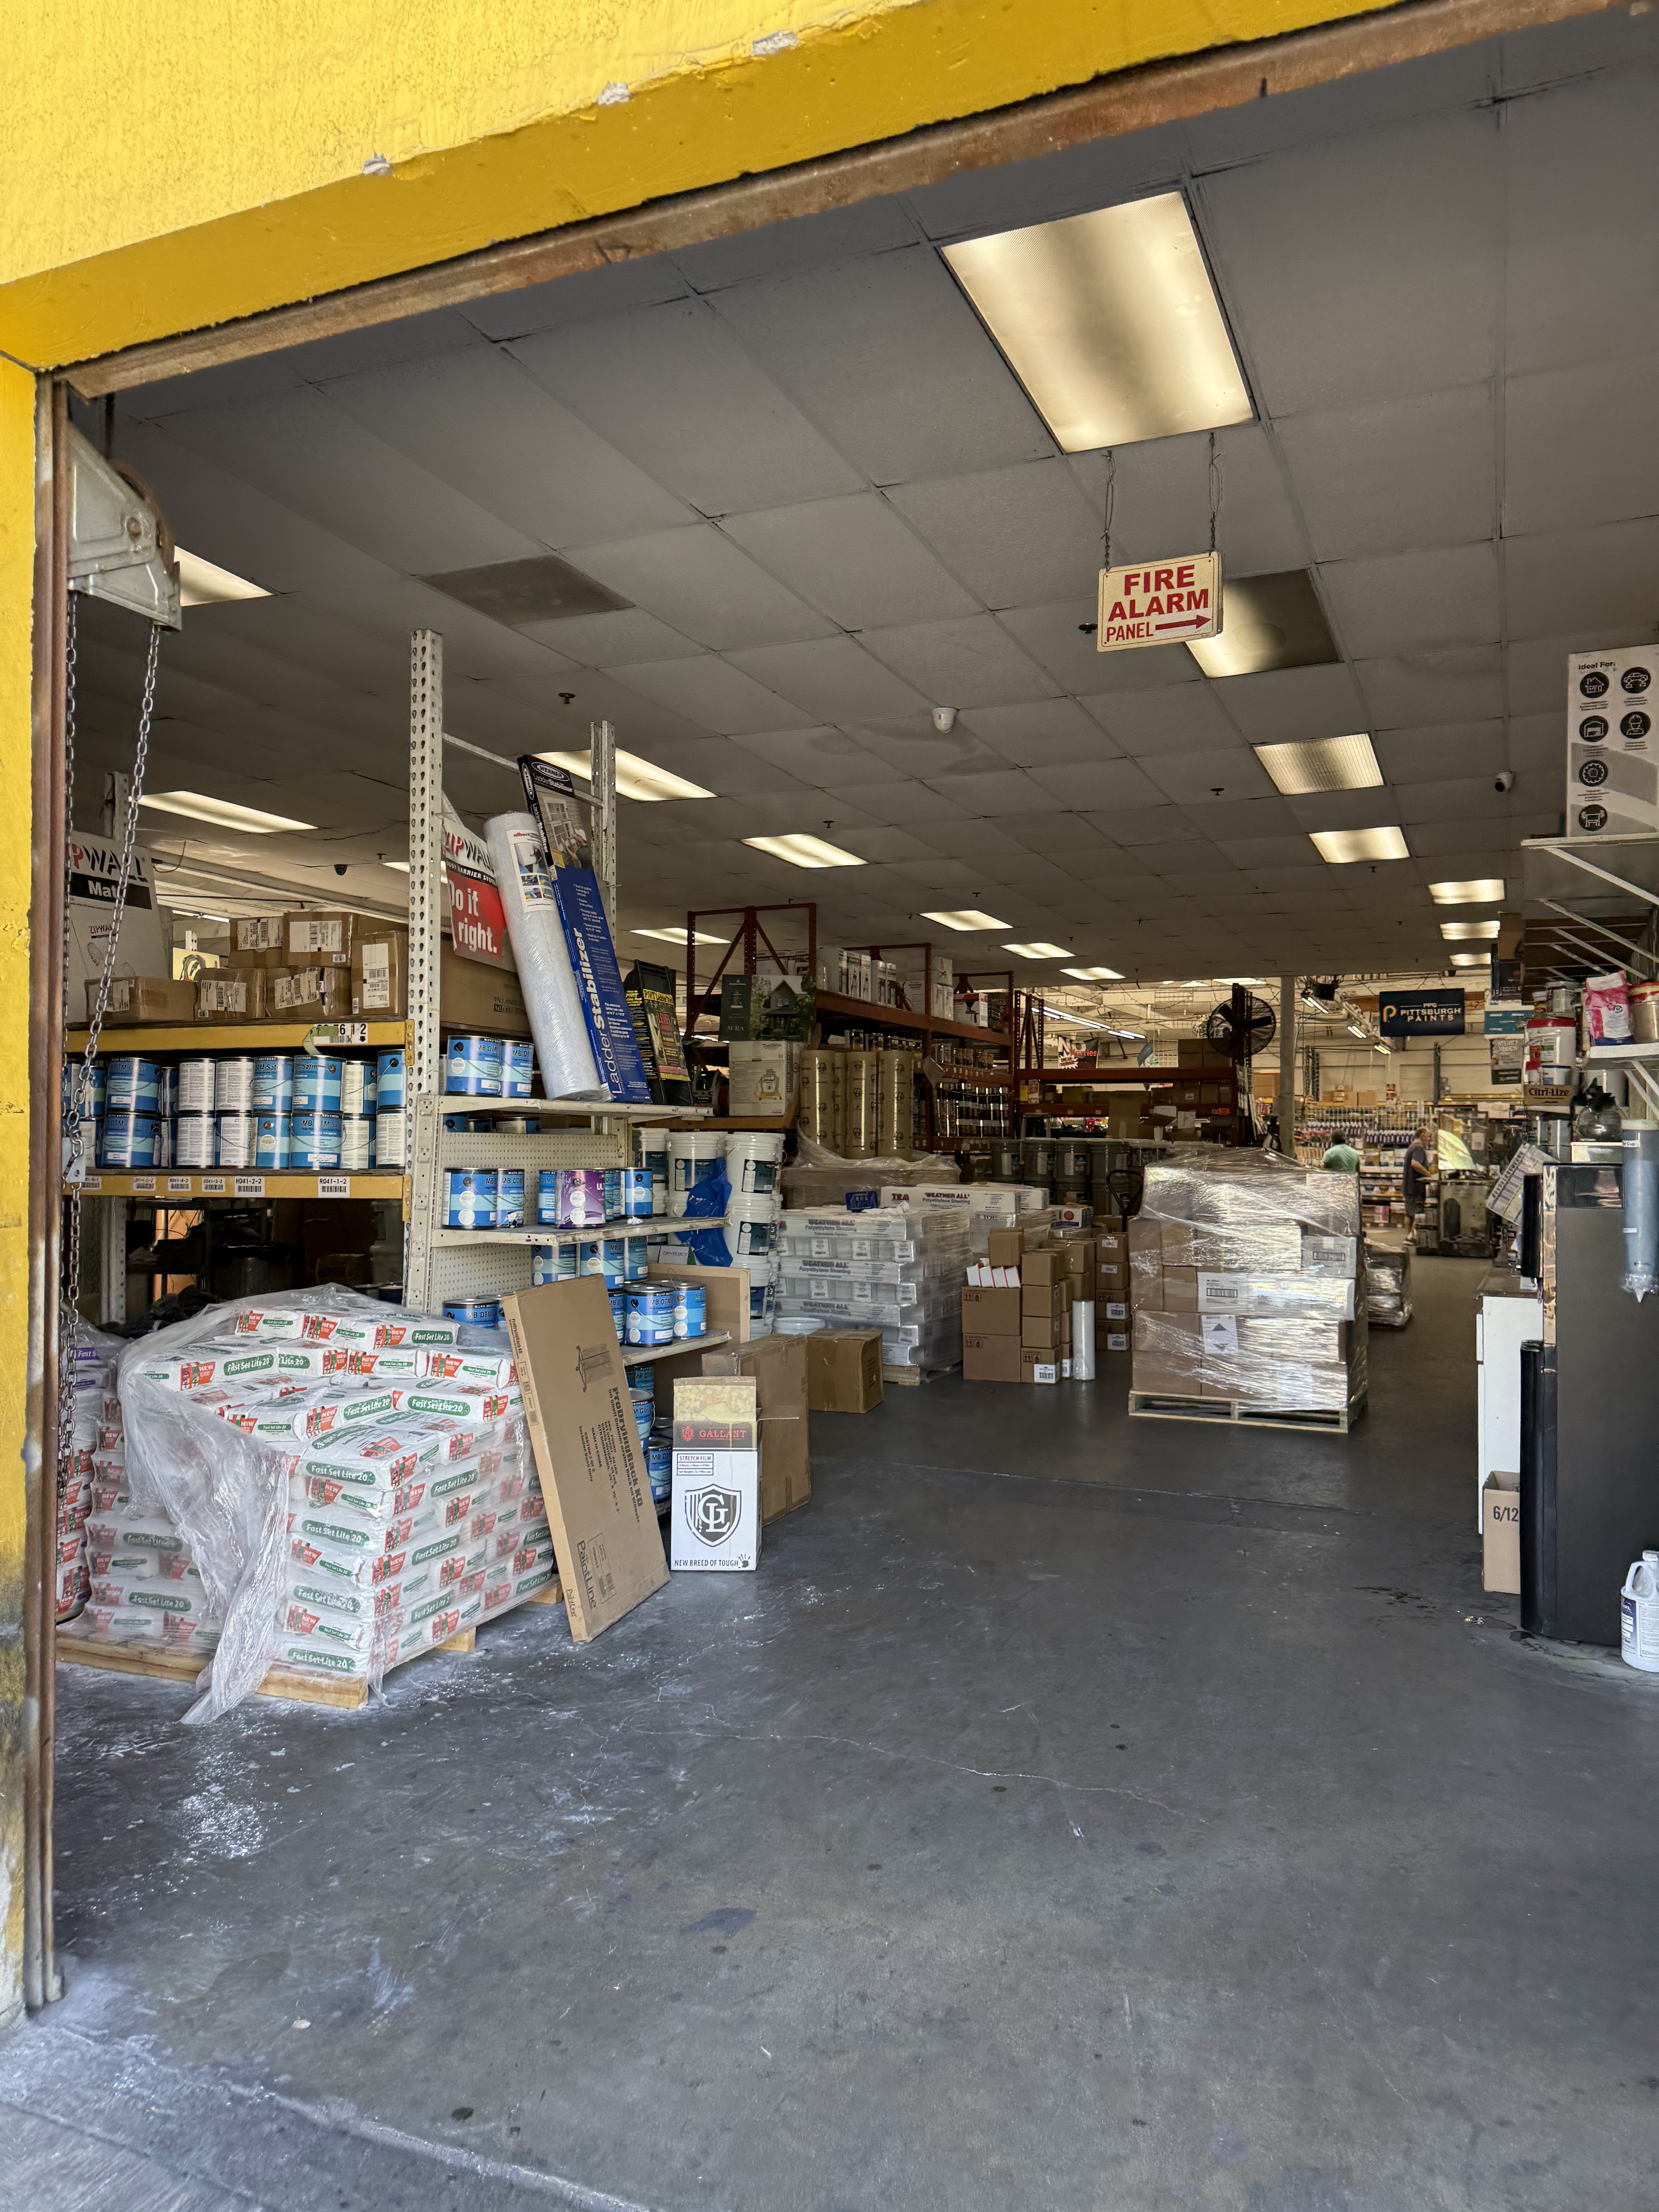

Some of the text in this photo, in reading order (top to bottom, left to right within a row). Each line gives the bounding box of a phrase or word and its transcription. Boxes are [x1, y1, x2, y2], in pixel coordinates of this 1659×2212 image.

[1124, 565, 1195, 596] FIRE
[1108, 589, 1209, 622] ALARM
[1107, 622, 1154, 642] PANEL
[540, 765, 562, 777] WERNER
[458, 866, 481, 879] BARRIER
[448, 879, 478, 917] Do it
[459, 917, 497, 953] right.
[574, 928, 622, 1094] LadderStabilizer
[1401, 1008, 1461, 1016] PITTSBURGH
[361, 1024, 366, 1034] 2
[228, 1363, 240, 1372] Fast
[240, 1361, 250, 1370] Set
[251, 1358, 262, 1369] Lite
[438, 1402, 454, 1411] Lite
[613, 1386, 643, 1507] ProDryingRack KD
[311, 1465, 368, 1481] Fast Set Lite 20
[325, 1484, 338, 1493] NEW
[434, 1473, 475, 1494] Fast Set Lite 20
[1493, 1505, 1518, 1522] 6/12
[307, 1524, 362, 1543] Fast Set Lite 20
[304, 1550, 318, 1559] NEW
[577, 1540, 597, 1610] PaintLine
[302, 1616, 316, 1624] NEW
[293, 1652, 348, 1668] Fast Set Lite 20
